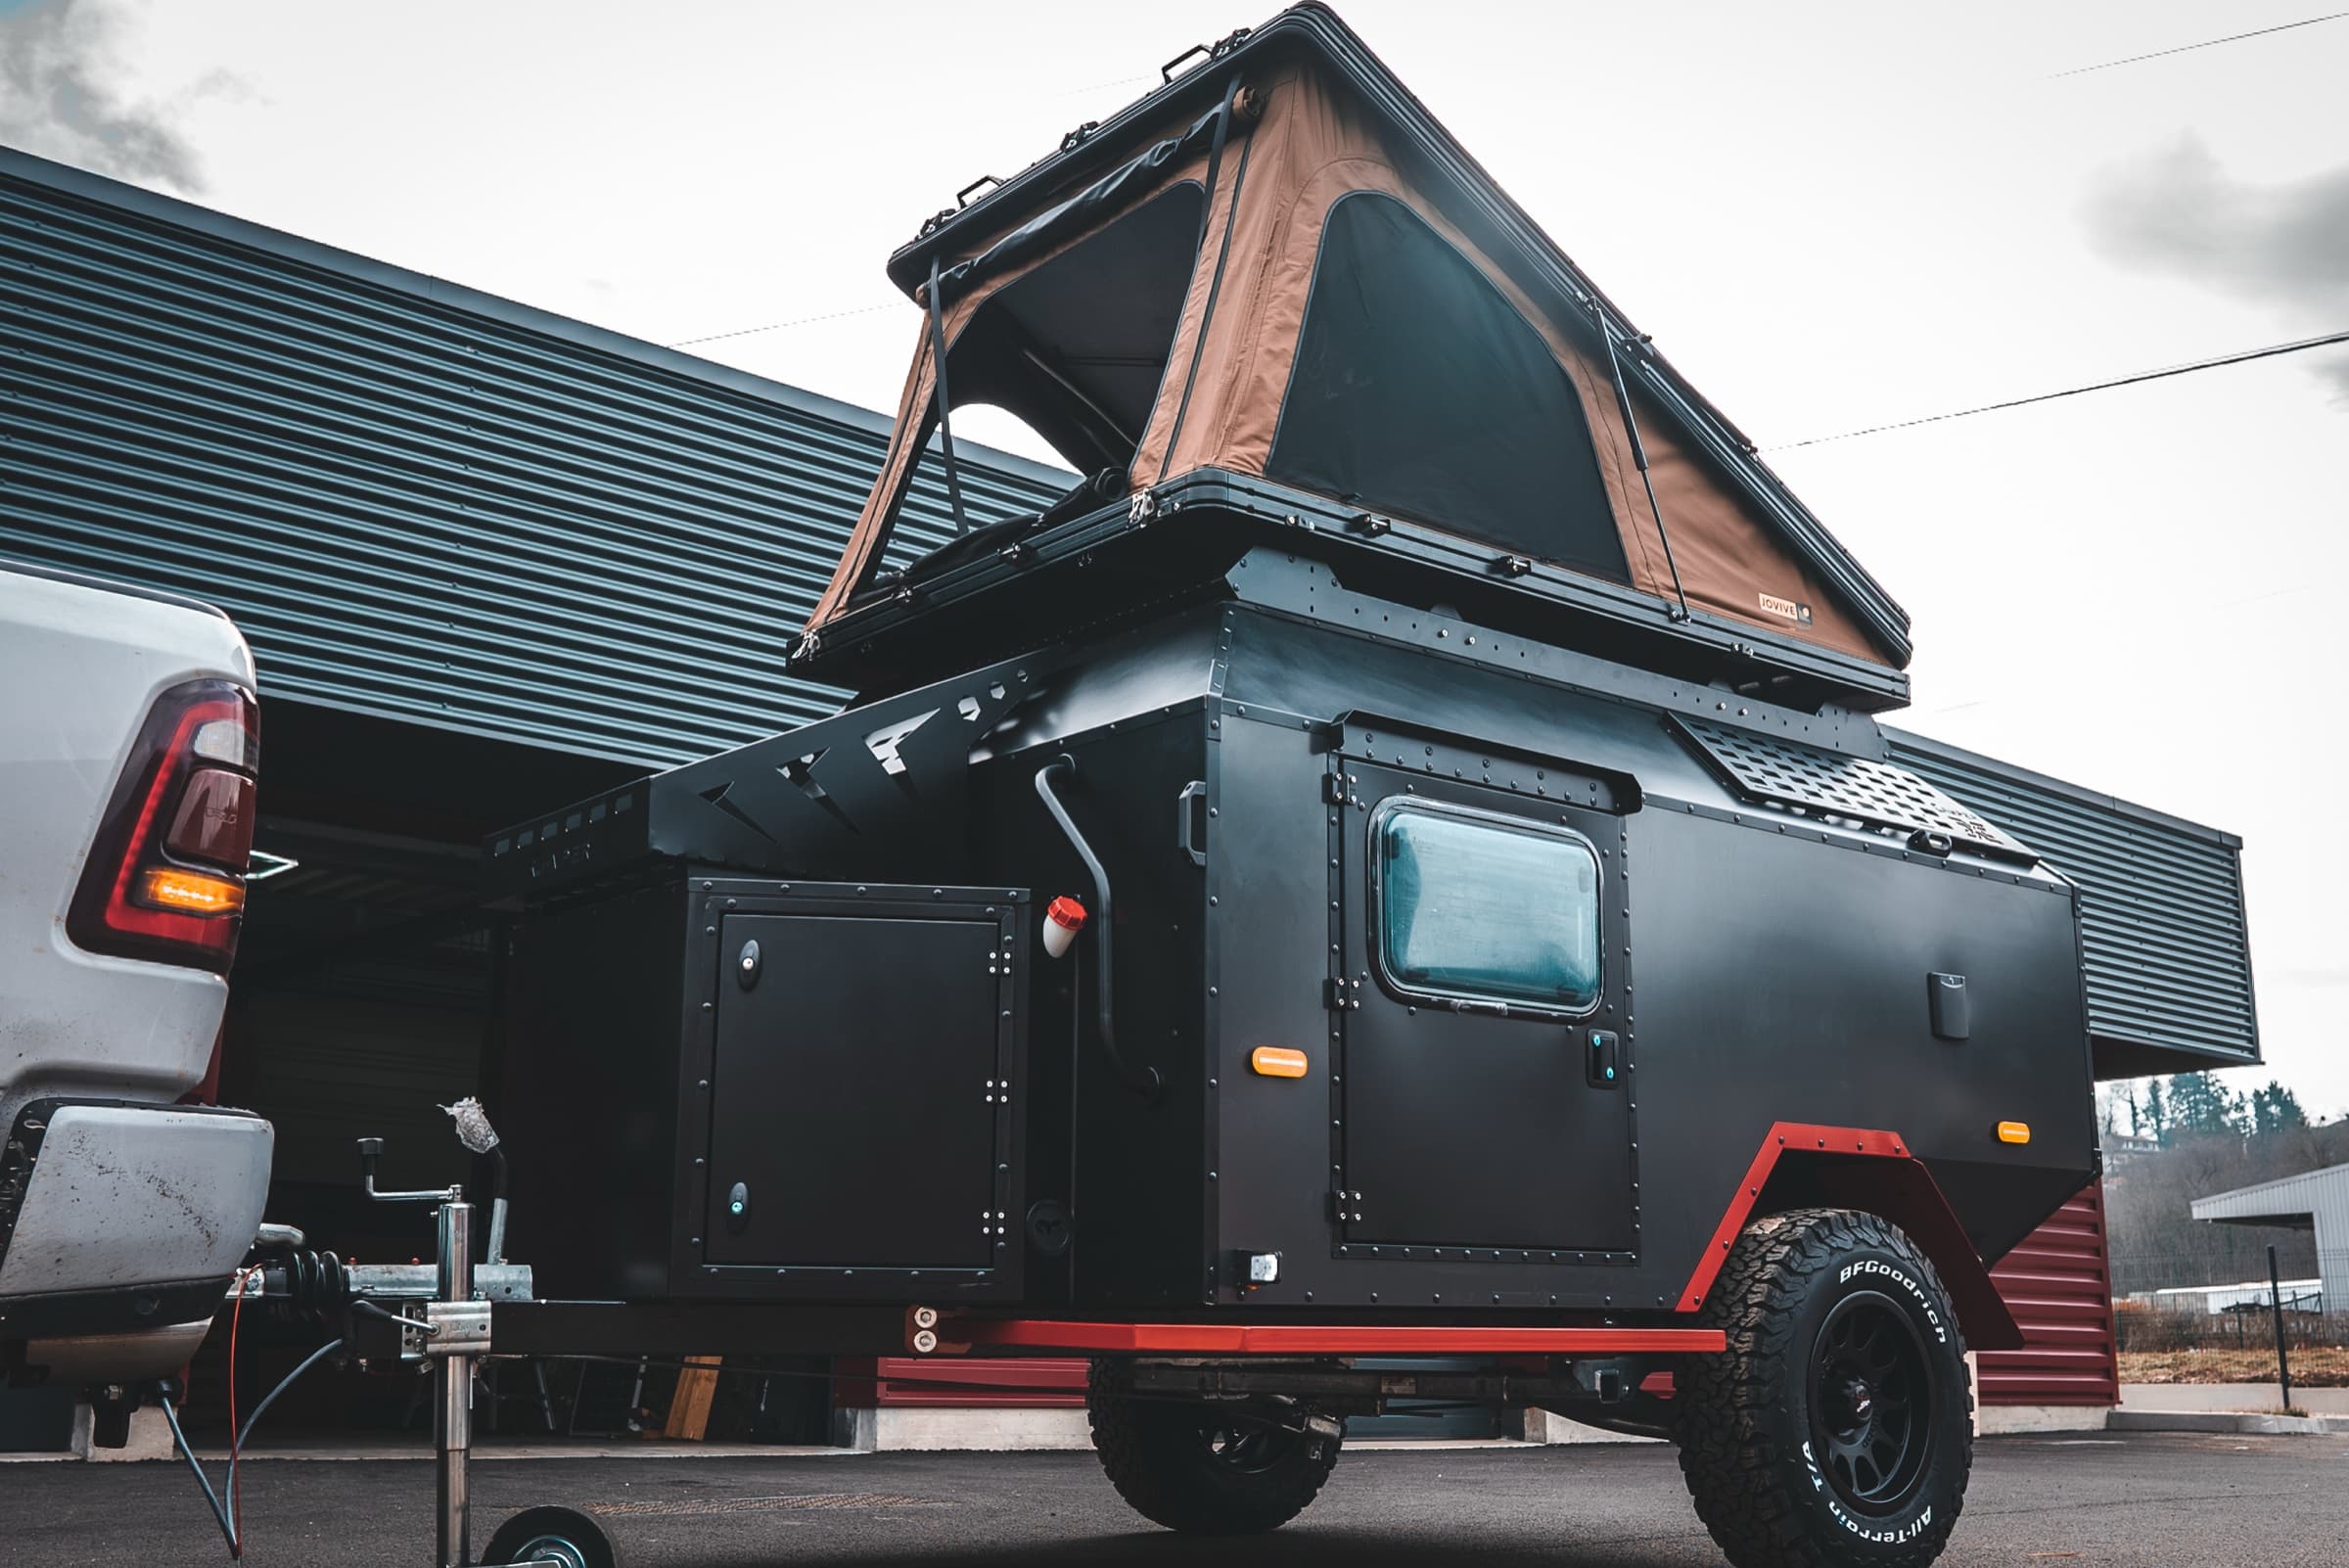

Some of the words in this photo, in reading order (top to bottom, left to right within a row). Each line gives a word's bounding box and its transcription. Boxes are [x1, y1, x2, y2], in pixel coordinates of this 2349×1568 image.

[1762, 596, 1796, 617] JOVIVE
[1840, 1260, 1946, 1343] BFGoodrich
[1802, 1441, 1823, 1492] T/A
[1828, 1500, 1932, 1544] All-Terrain
